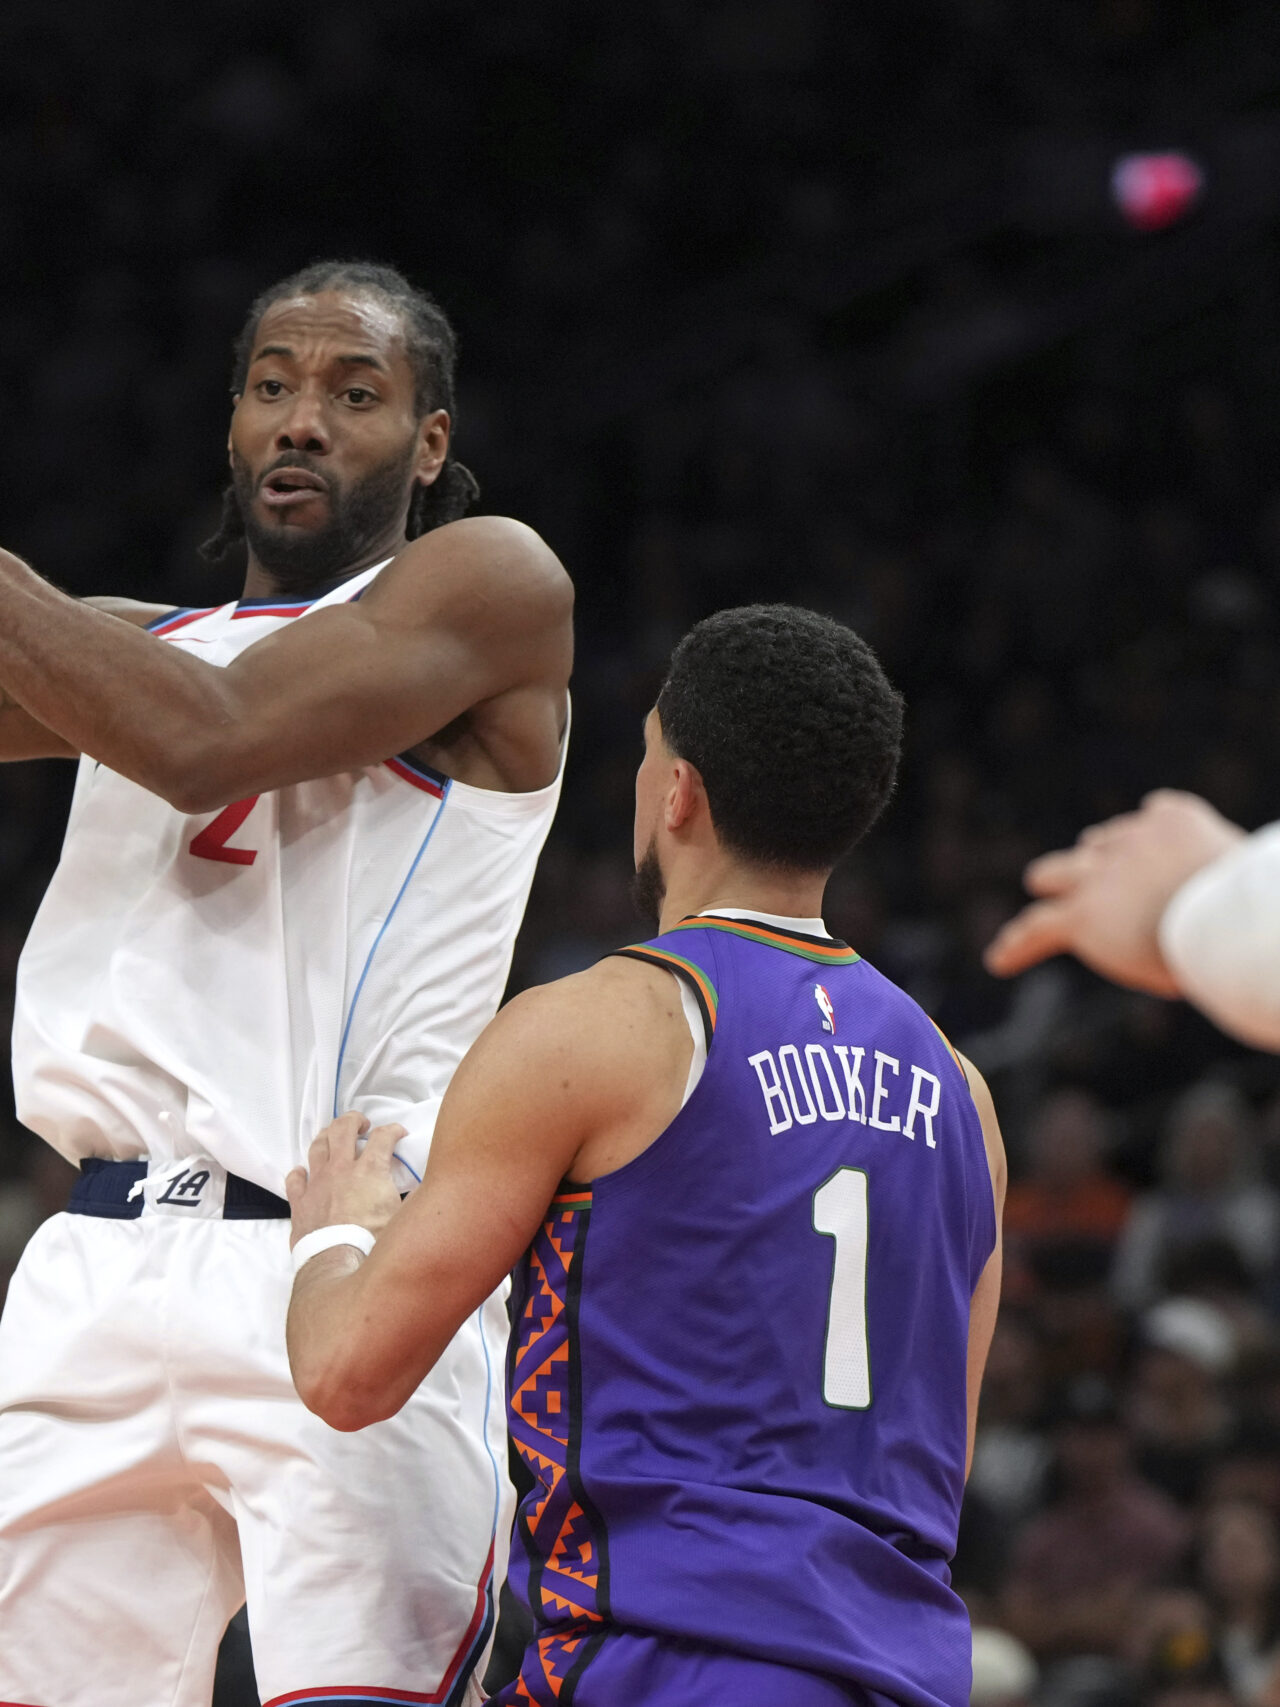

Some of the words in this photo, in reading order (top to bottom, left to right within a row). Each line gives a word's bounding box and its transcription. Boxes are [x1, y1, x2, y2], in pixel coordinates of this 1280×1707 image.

[748, 1044, 942, 1149] BOOKER
[156, 1168, 211, 1207] LA
[813, 1164, 873, 1411] 1
